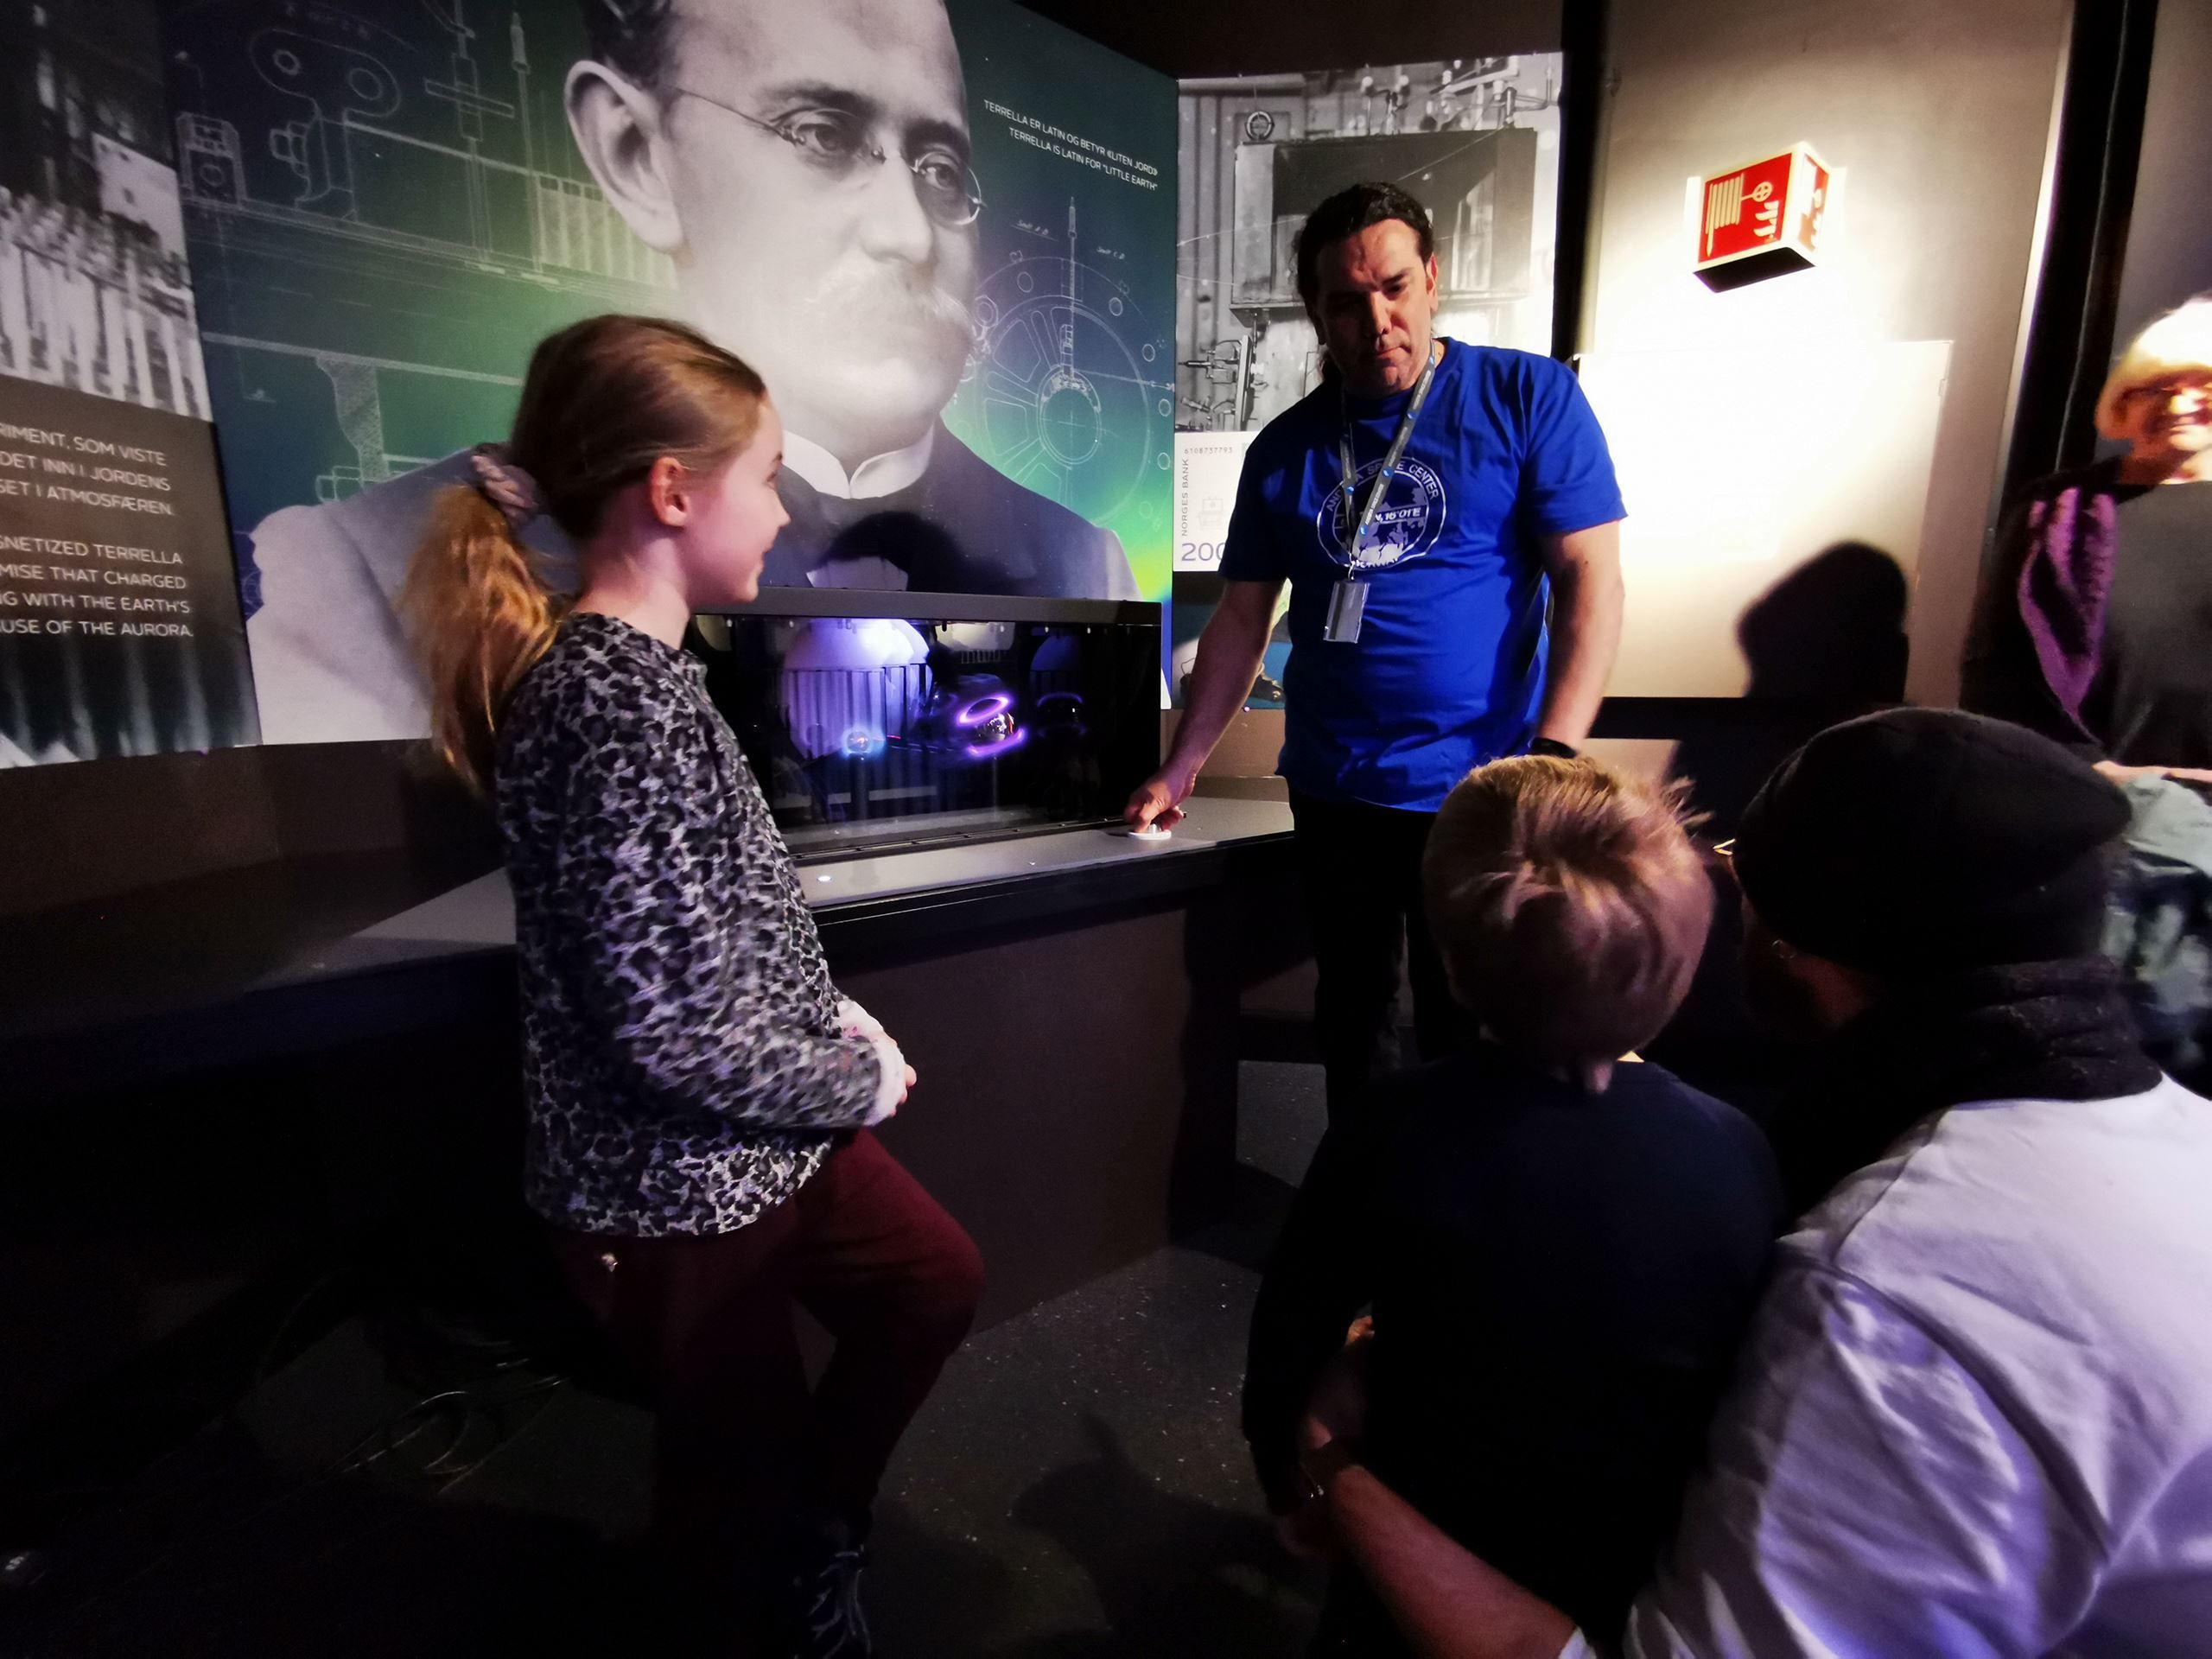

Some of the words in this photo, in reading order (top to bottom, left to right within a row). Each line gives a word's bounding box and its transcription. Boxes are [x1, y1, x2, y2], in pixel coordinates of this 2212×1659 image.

[983, 99, 1028, 125] TERRELLA
[1029, 118, 1041, 130] ER
[1042, 124, 1066, 140] LATIN
[1066, 133, 1079, 146] OG
[1080, 138, 1105, 157] BETYR
[1009, 127, 1051, 152] TERRELLA
[1052, 145, 1060, 156] IS
[1061, 149, 1084, 165] LATIN
[1085, 157, 1102, 171] FOR
[73, 436, 114, 456] SOM
[118, 445, 167, 467] VISTE
[43, 459, 75, 475] INN
[79, 465, 84, 476] I
[91, 467, 171, 491] JORDENS
[1408, 463, 1439, 500] CENTER
[36, 485, 41, 497] I
[93, 543, 183, 564] TERRELLA
[49, 566, 99, 582] THAT
[104, 570, 186, 589] CHARGED
[22, 593, 74, 607] WITH
[79, 595, 116, 610] THE
[121, 597, 190, 613] EARTH'S
[46, 620, 73, 634] OF
[79, 621, 115, 635] THE
[121, 623, 194, 638] AURORA.
